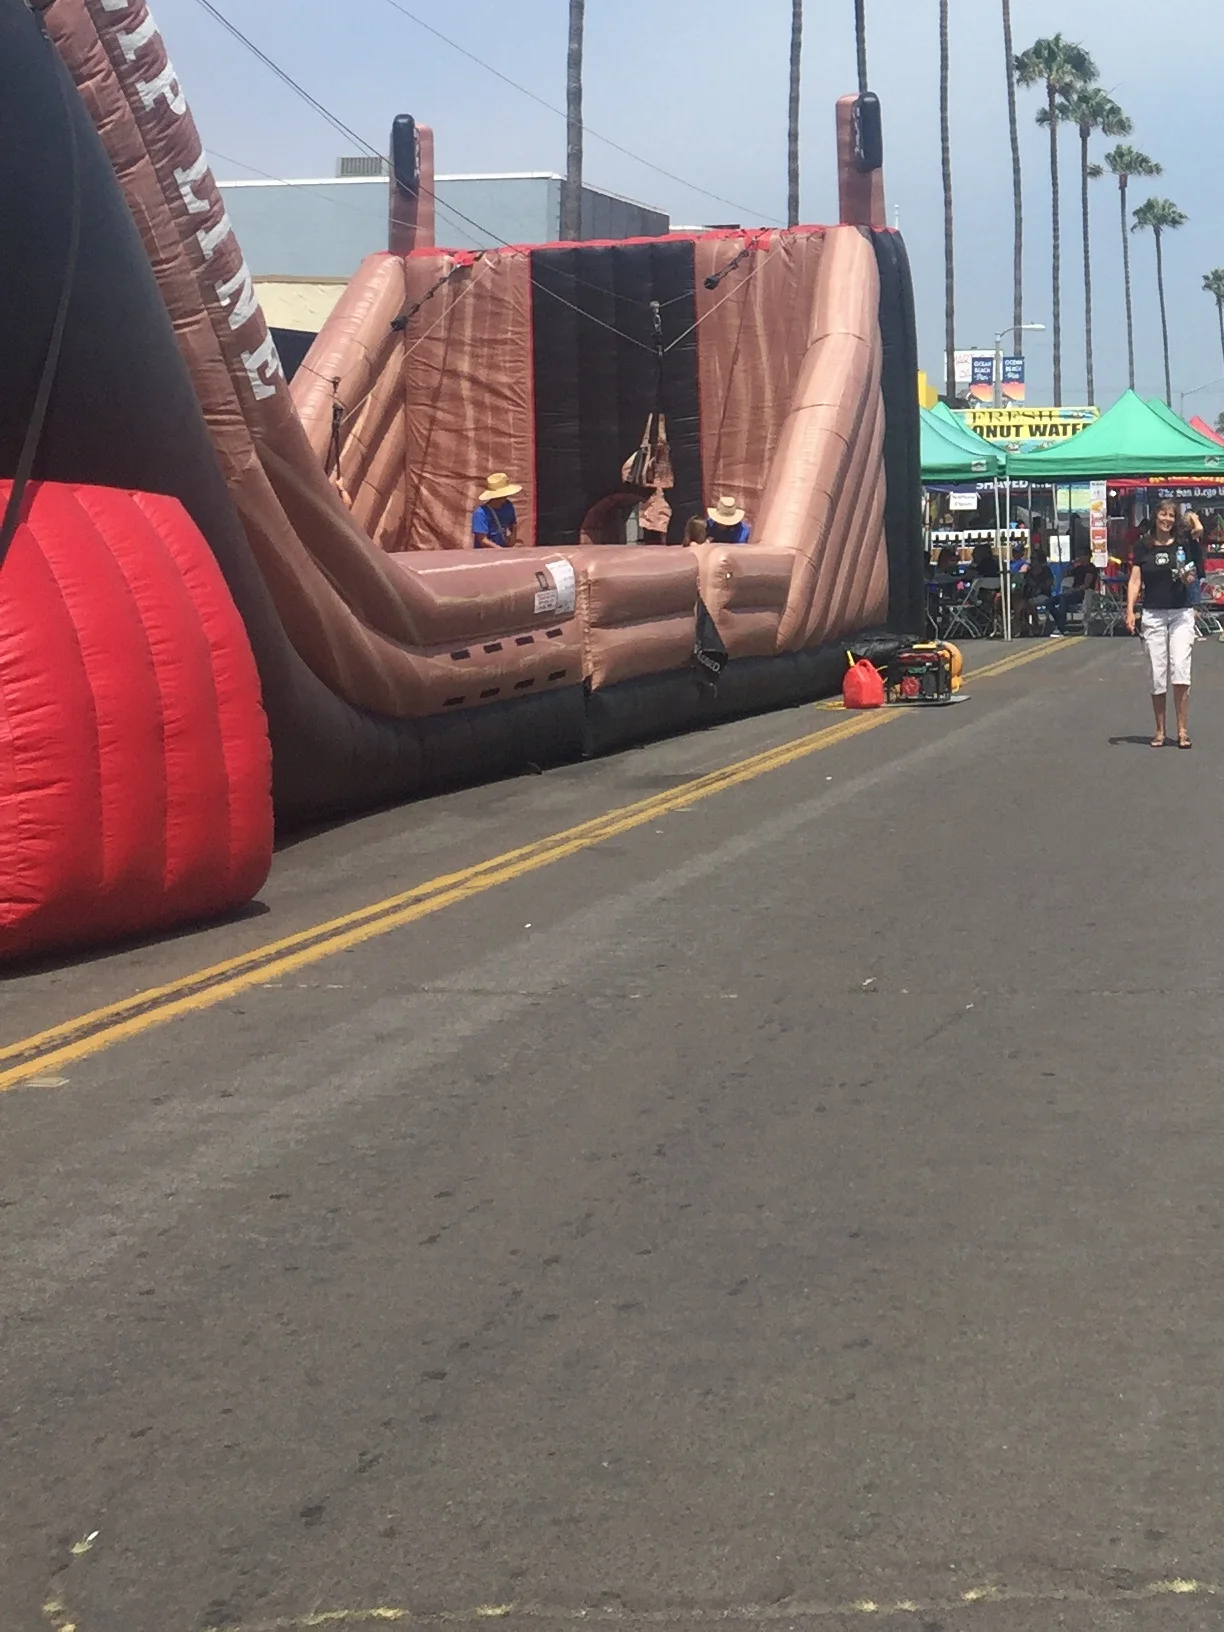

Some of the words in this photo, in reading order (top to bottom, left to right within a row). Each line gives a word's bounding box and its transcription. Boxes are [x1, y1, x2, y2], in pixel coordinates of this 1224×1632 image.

[173, 148, 285, 401] LINE
[971, 410, 1056, 423] FRESH
[974, 424, 1023, 438] ONUT
